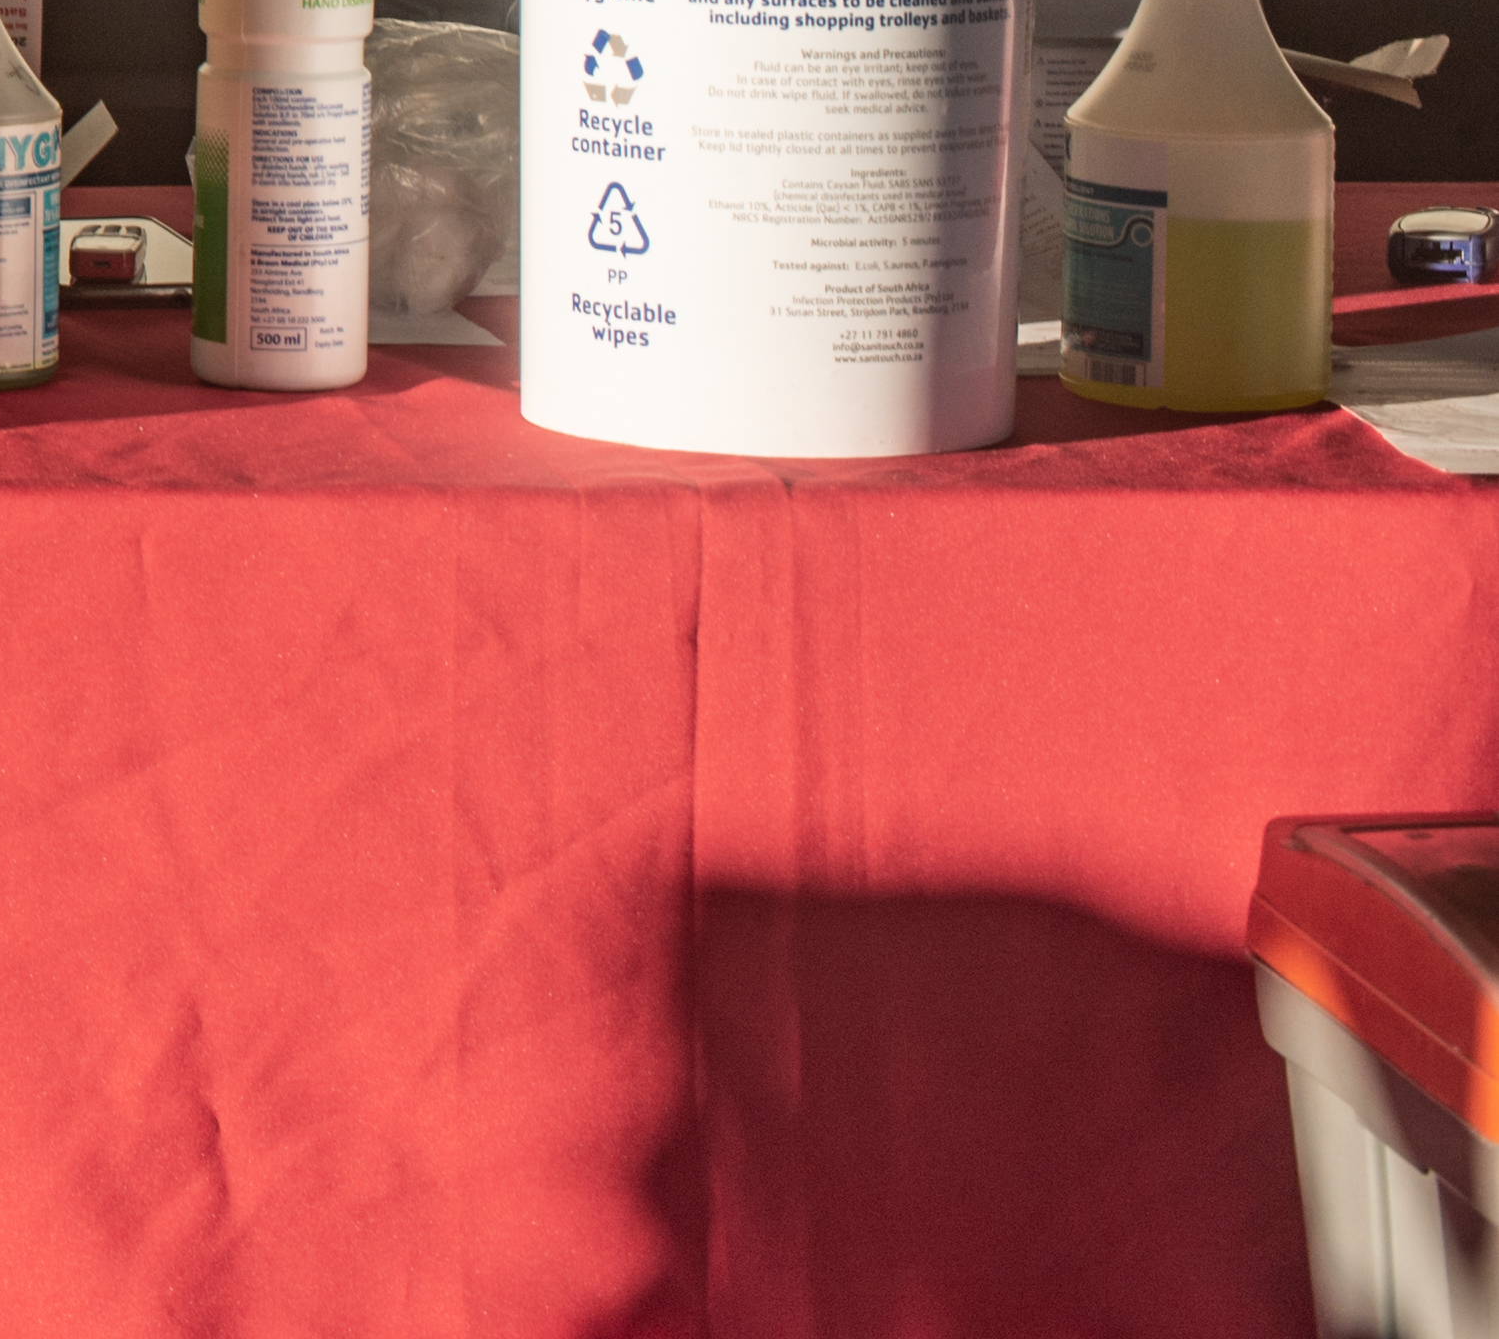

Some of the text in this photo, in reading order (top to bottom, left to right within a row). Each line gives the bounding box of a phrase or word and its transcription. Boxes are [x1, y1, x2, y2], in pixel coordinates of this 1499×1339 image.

[710, 9, 789, 30] including
[795, 10, 875, 31] shopping
[880, 9, 938, 29] trolleys
[942, 9, 964, 24] and
[802, 48, 947, 62] Warnings and Precautions:
[754, 61, 780, 73] Fluid
[786, 64, 803, 73] can
[808, 62, 821, 73] be
[825, 64, 838, 73] an
[842, 65, 860, 77] eye
[906, 62, 928, 75] keep
[931, 61, 946, 72] out
[737, 74, 944, 89] In case of contact with eyes, rinse eyes
[709, 86, 943, 103] Do not drink wipe fluid. If swallowed, do not
[825, 102, 928, 114] seek medical advice.
[579, 109, 653, 139] Recycle
[691, 125, 931, 143] Store in sealed plastic containers as supplied
[572, 134, 666, 161] container
[698, 140, 937, 157] Keep lid tightly closed at all times to prevent
[851, 168, 907, 181] Ingredients:
[608, 211, 624, 236] 5
[300, 233, 333, 241] CHILDREN
[811, 235, 940, 249] Microbial activity: 5 minutes
[773, 260, 808, 271] Tested
[810, 261, 849, 273] against:
[608, 268, 627, 285] PP
[825, 282, 930, 295] Product of South Africa
[792, 295, 834, 305] Infection
[837, 296, 883, 305] Protection
[886, 294, 921, 304] Products
[572, 294, 676, 325] Recyclable
[785, 307, 910, 320] Susan Street, Strijdom Park,
[257, 333, 301, 345] 500 ml
[592, 323, 649, 348] wipes
[839, 328, 919, 340] +27 11 791 4860
[832, 342, 924, 354] info@sanitouch.co.za
[834, 354, 923, 363] www.sanitouch.co.za
